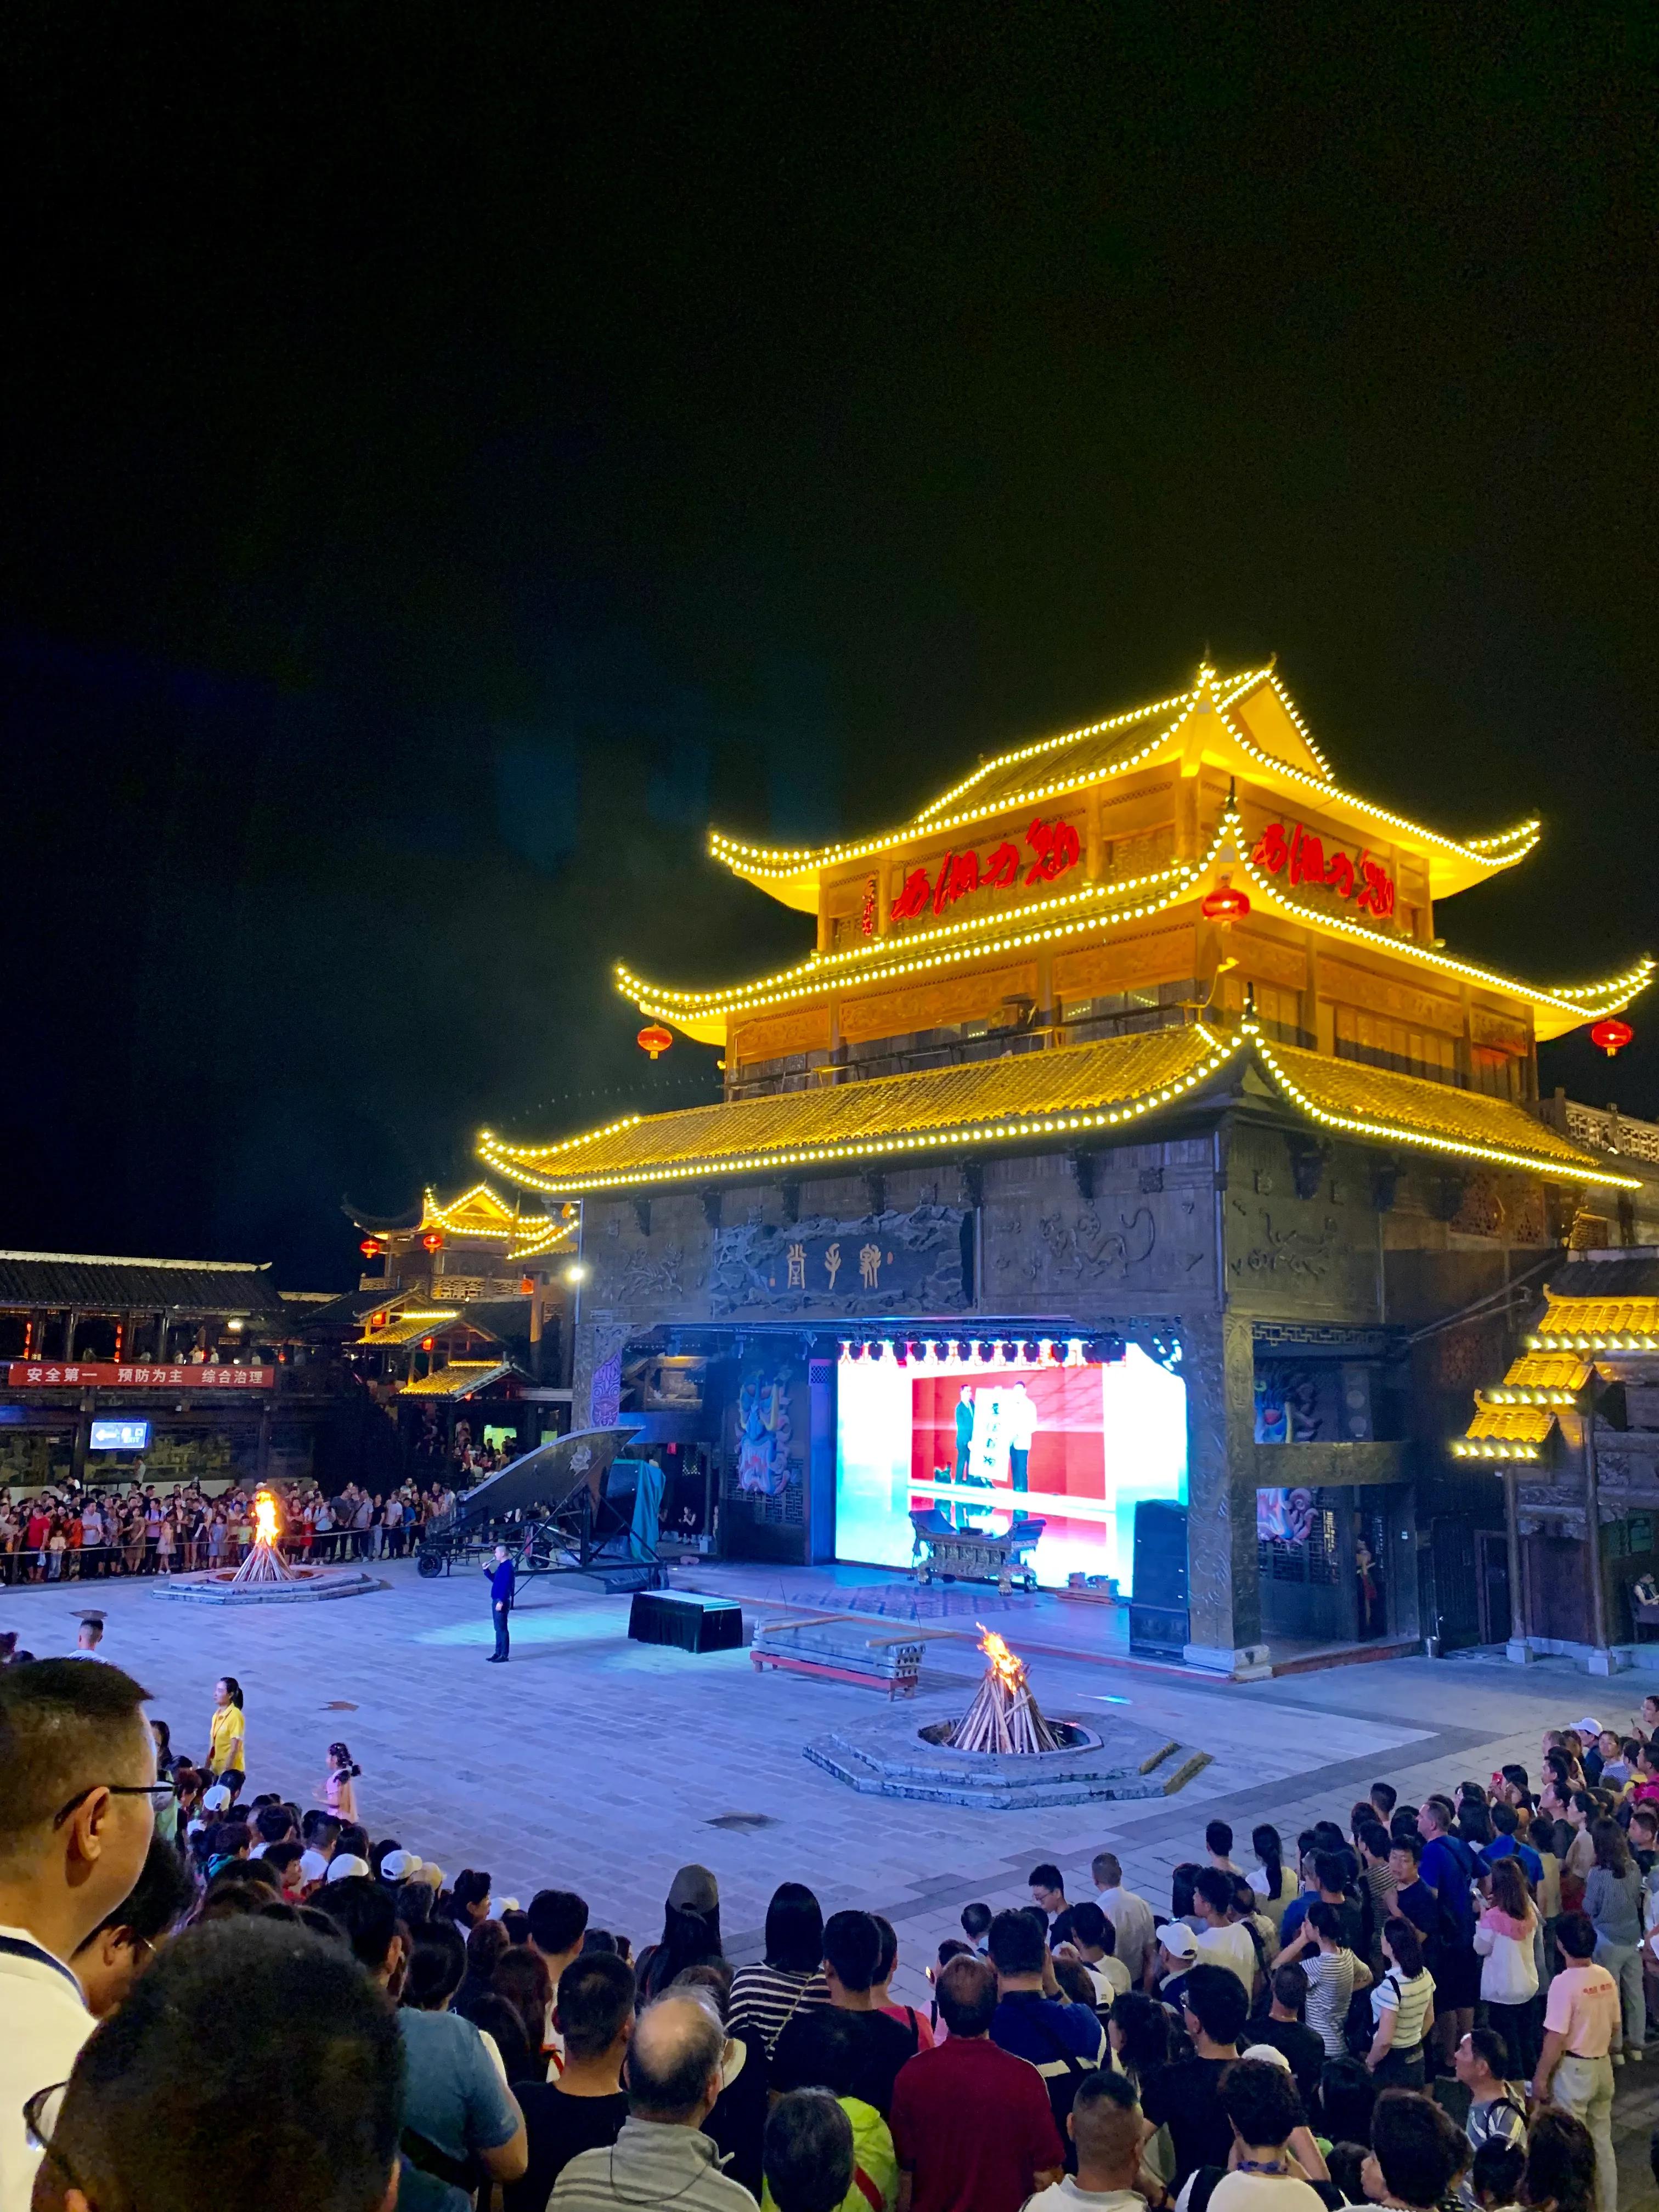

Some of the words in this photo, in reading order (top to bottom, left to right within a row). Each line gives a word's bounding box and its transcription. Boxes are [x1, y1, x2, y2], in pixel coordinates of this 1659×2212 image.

[27, 1368, 97, 1382] 安全第一
[118, 1368, 182, 1383] 预防为主
[202, 1369, 263, 1384] 综合治理
